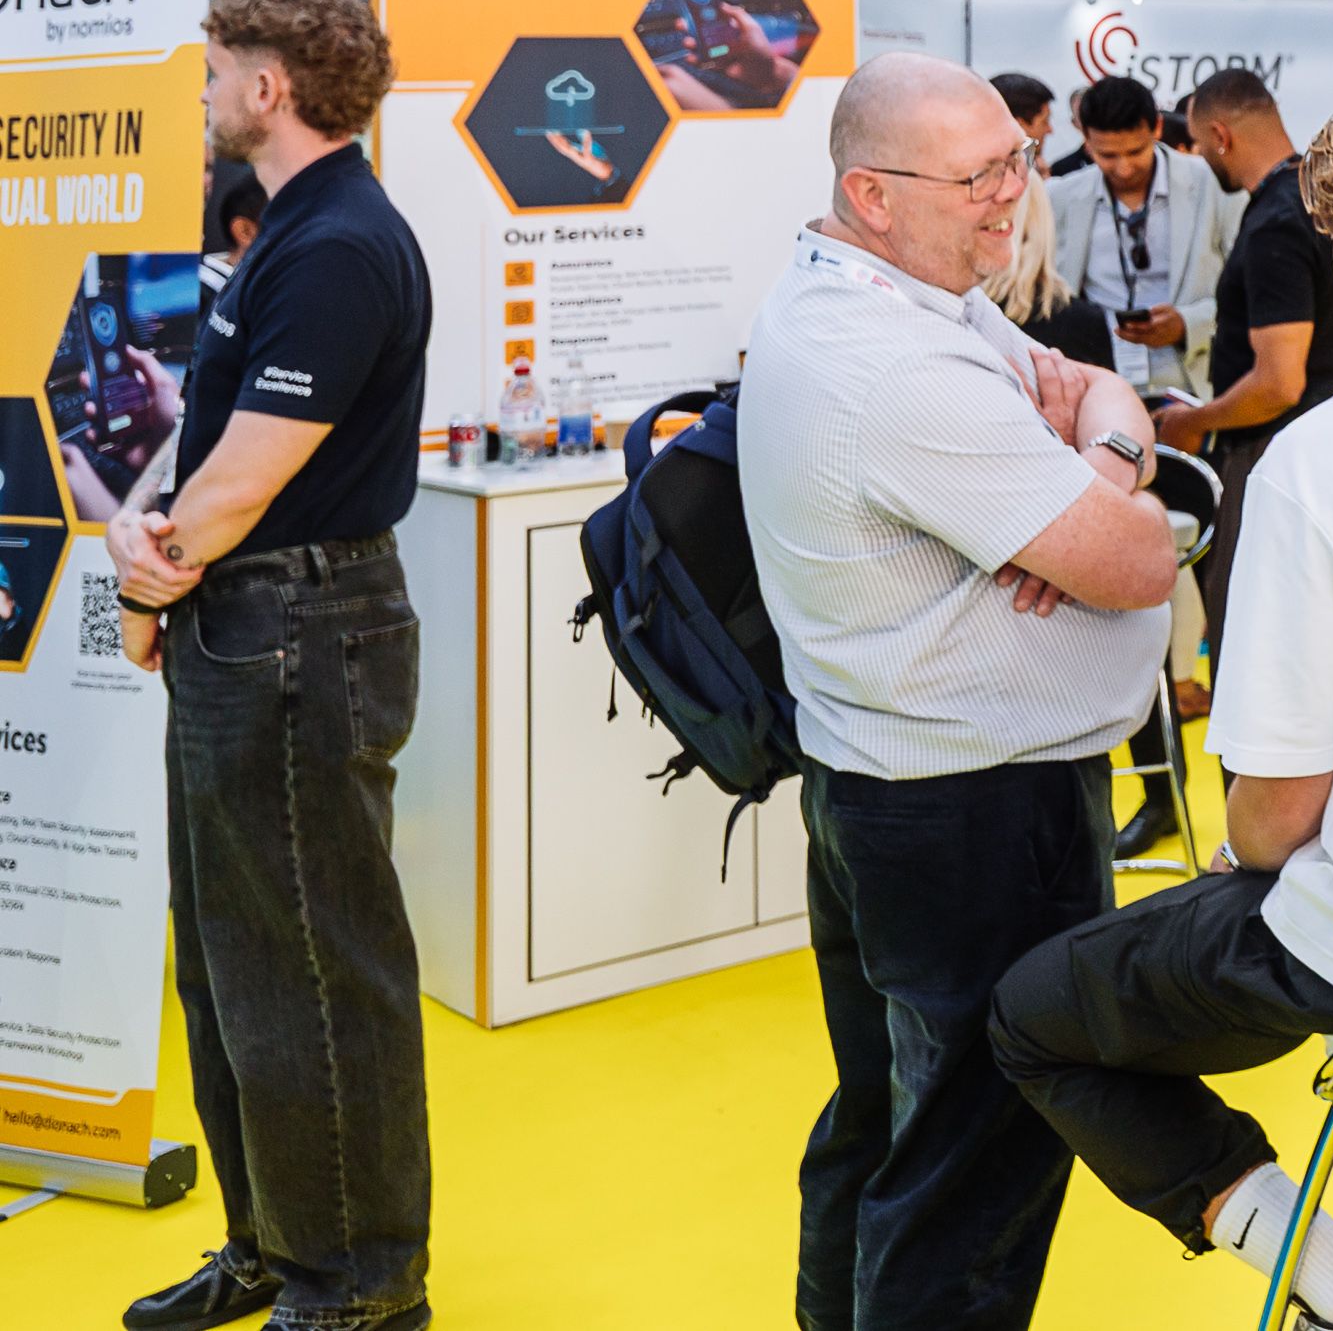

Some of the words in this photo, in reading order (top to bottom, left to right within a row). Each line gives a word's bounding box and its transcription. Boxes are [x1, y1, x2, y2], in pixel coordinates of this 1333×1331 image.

[46, 18, 66, 44] by
[69, 15, 134, 39] nomios
[0, 110, 107, 163] ECURITY
[114, 109, 143, 156] IN
[0, 174, 51, 228] UAL
[56, 172, 144, 226] WORLD
[504, 227, 545, 246] Our
[554, 222, 646, 244] Services
[0, 721, 47, 754] ices
